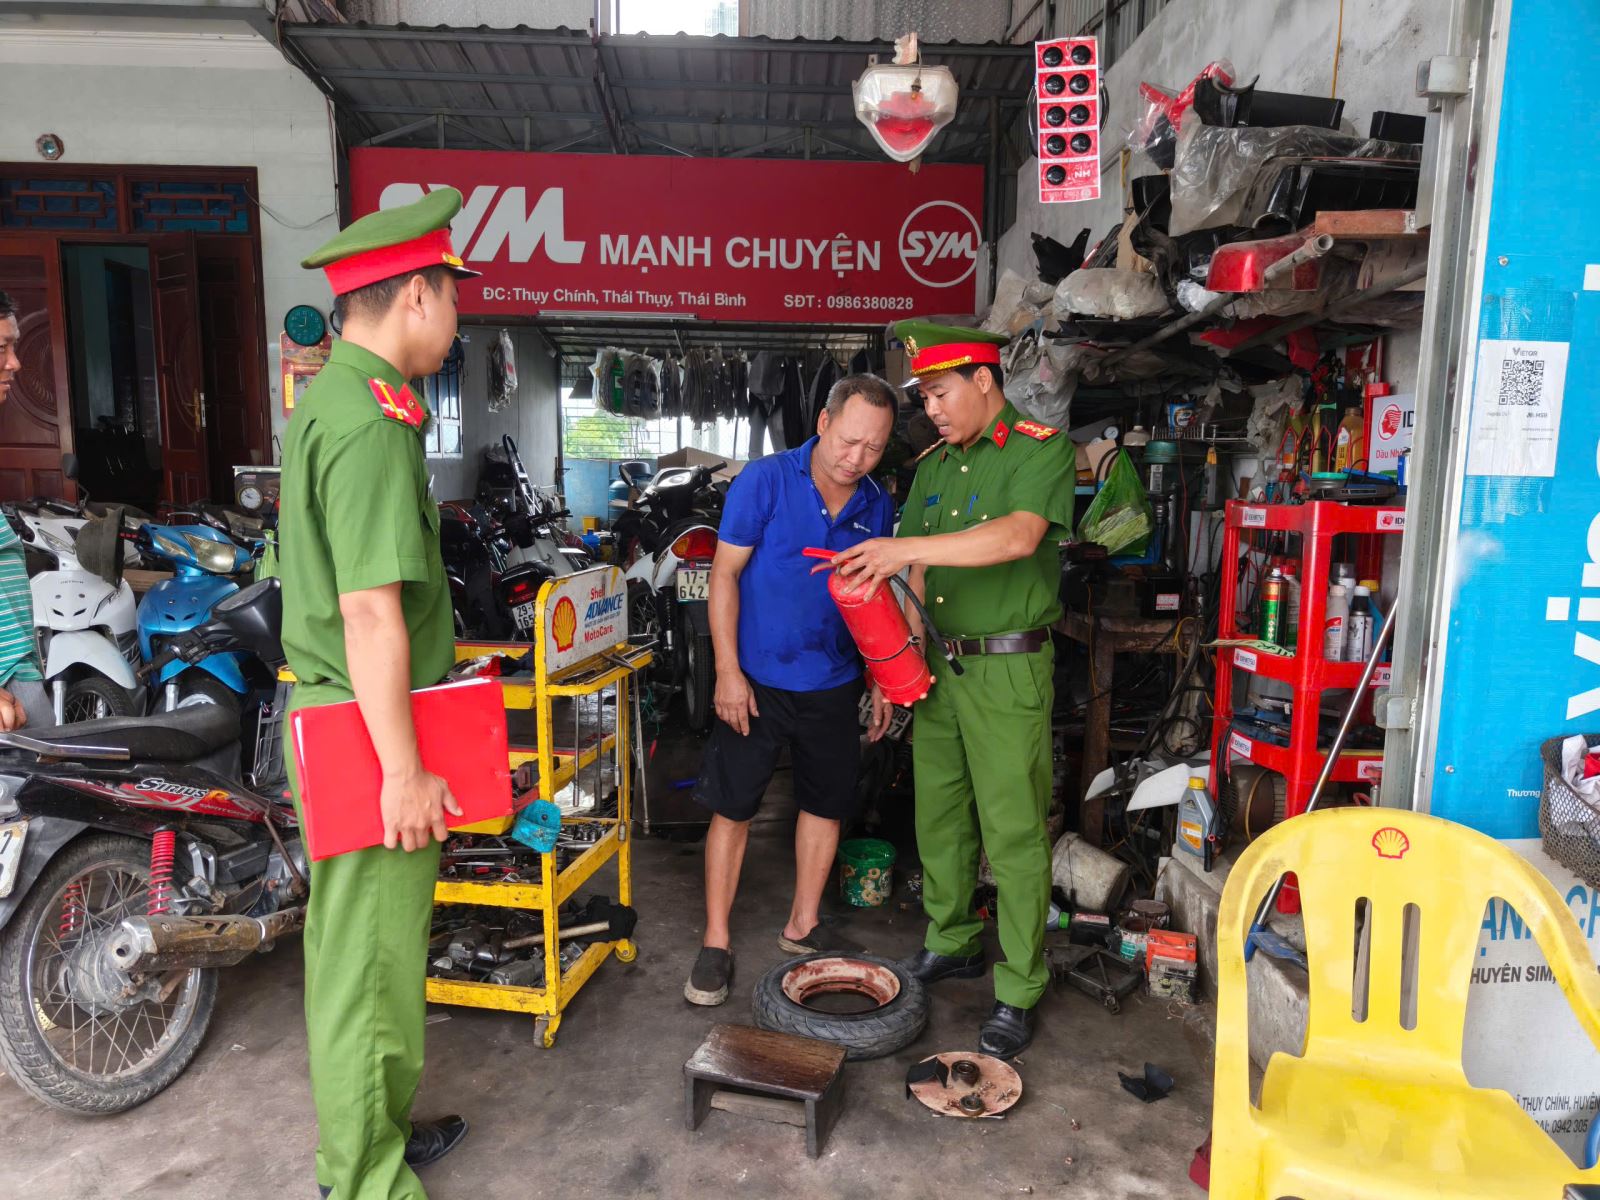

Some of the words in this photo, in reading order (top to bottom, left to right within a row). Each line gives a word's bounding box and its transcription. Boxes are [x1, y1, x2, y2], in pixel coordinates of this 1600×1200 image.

[379, 183, 586, 263] YM
[600, 234, 711, 273] MẠNH
[725, 232, 881, 278] CHUYỆN
[902, 230, 976, 266] SYM
[553, 289, 599, 304] Chính,
[602, 290, 633, 304] Thái
[636, 291, 674, 307] Thụy,
[678, 291, 710, 305] Thái
[714, 292, 746, 306] Bình
[826, 296, 914, 310] 0986380828
[590, 584, 606, 600] Shell
[584, 592, 624, 621] ADVANCE
[584, 624, 614, 643] MotoCare
